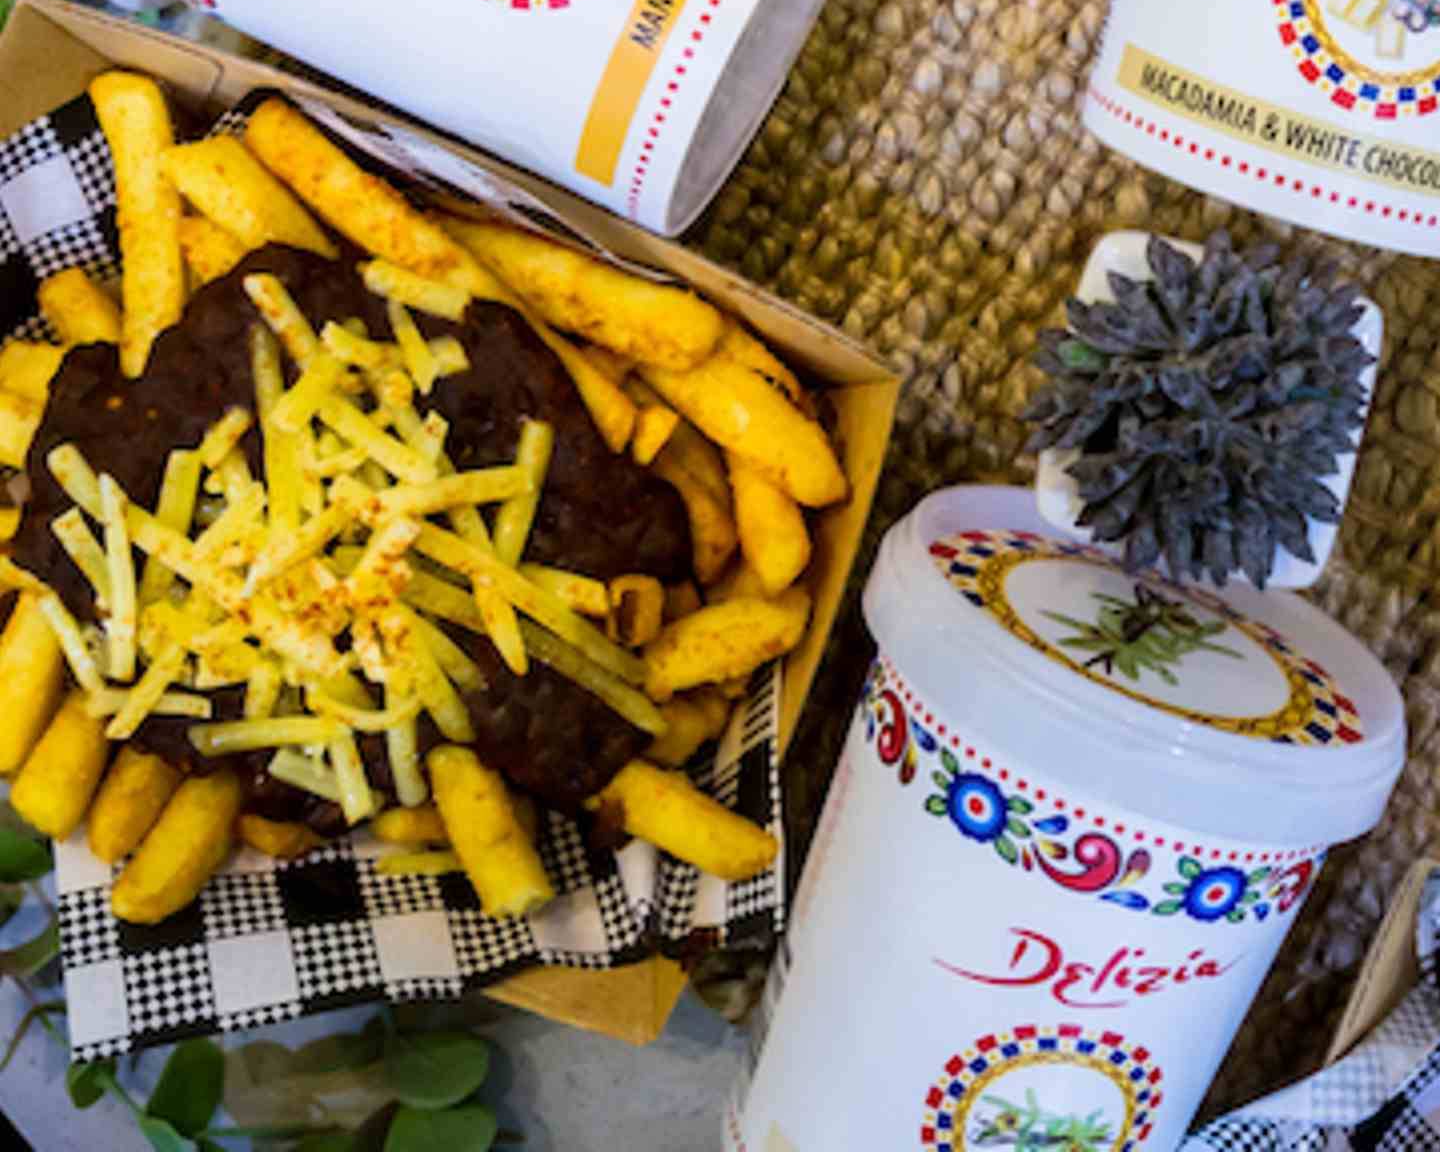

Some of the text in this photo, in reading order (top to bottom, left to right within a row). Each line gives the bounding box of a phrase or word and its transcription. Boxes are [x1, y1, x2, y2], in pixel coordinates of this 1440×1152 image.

[1139, 62, 1258, 134] MACADAMIA
[1258, 111, 1281, 142] &
[1284, 119, 1361, 168] WHITE
[930, 927, 1248, 1009] Delizia
